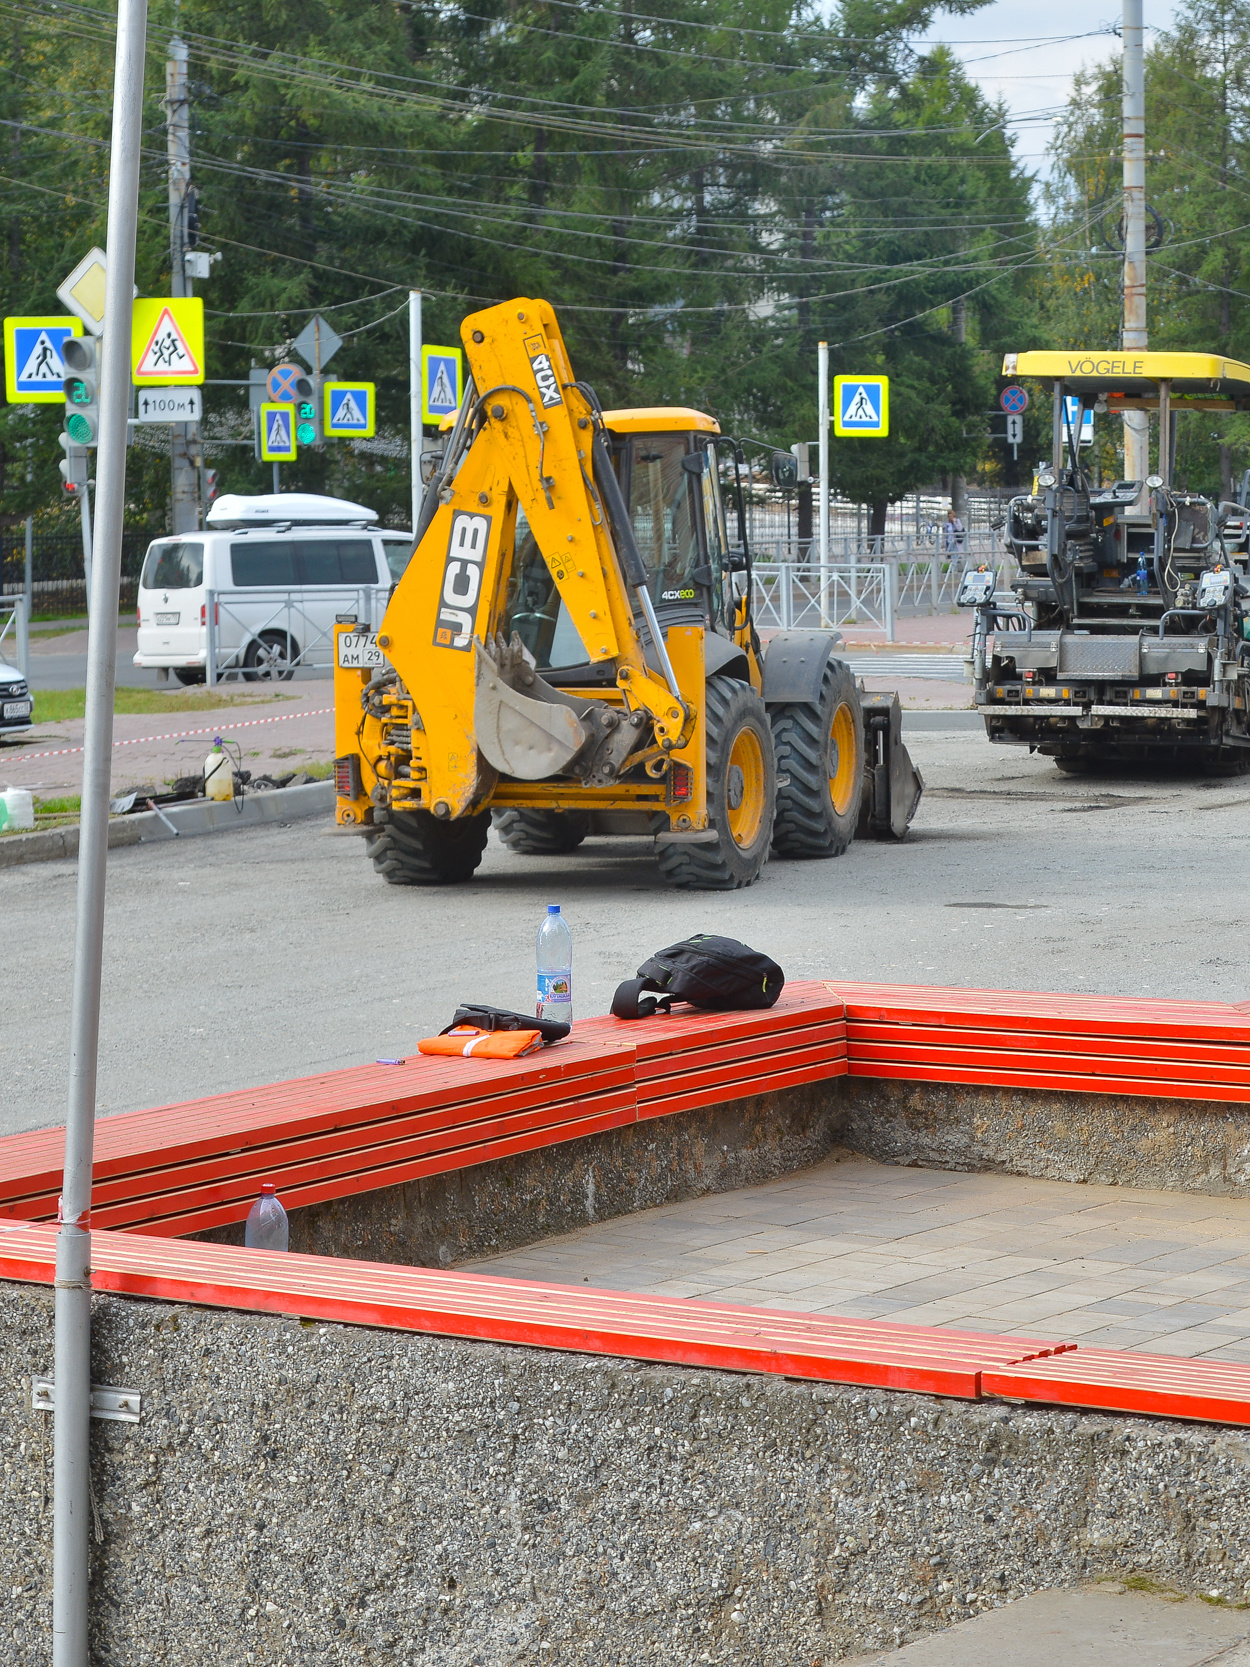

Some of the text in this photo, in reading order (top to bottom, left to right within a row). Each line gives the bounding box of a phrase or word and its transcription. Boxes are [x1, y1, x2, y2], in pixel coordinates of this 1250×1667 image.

[1067, 356, 1144, 375] VÖGELE
[532, 353, 562, 403] 4CX
[439, 514, 488, 648] JCB
[344, 634, 378, 649] 0774
[367, 650, 381, 661] 29
